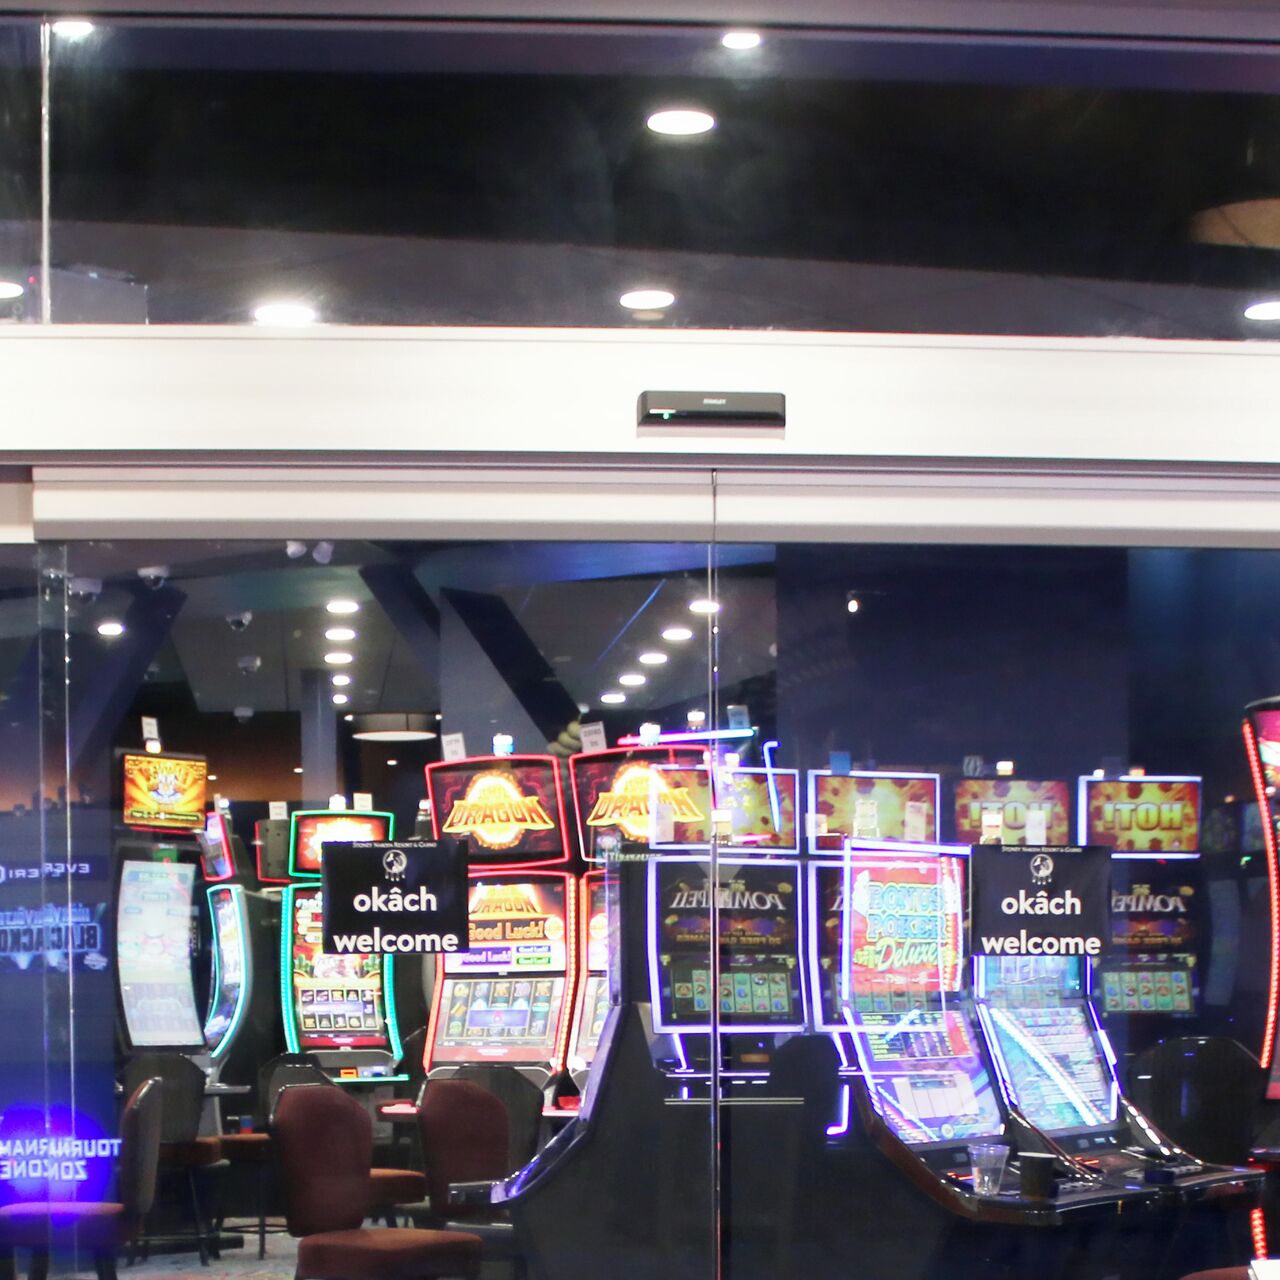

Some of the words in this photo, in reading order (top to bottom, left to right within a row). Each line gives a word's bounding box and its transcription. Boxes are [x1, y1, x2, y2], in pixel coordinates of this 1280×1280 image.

[443, 796, 555, 833] DRAGON
[353, 885, 437, 912] okâch
[868, 882, 945, 914] BONUS
[1000, 889, 1082, 915] okâch
[332, 926, 460, 953] welcome
[867, 913, 946, 942] POKER
[876, 937, 940, 972] Deluxe
[981, 929, 1102, 955] welcome
